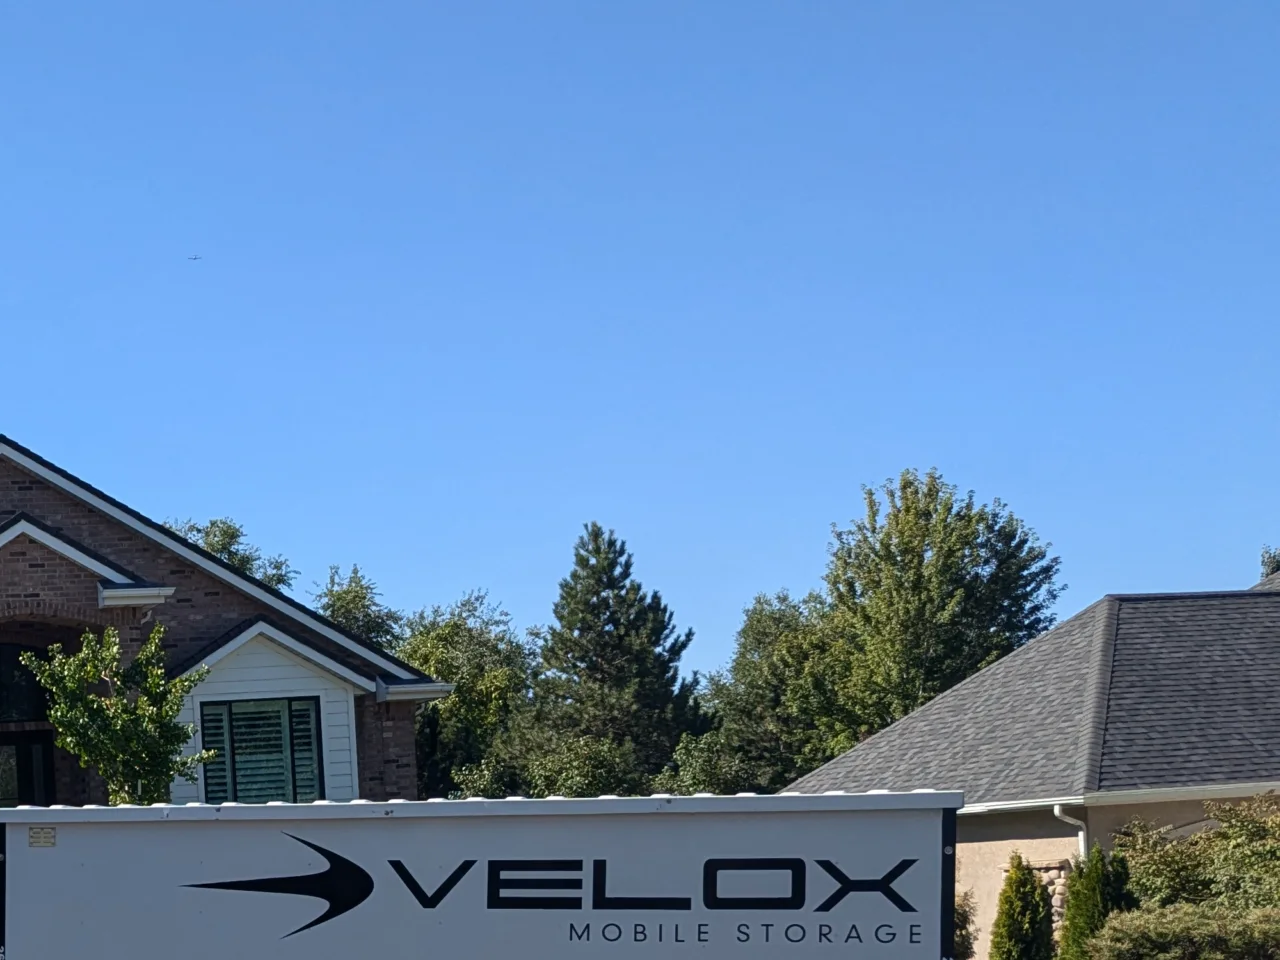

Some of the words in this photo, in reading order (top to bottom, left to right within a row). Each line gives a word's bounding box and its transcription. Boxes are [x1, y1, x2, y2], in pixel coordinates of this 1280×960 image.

[386, 857, 920, 913] VELOX
[569, 922, 709, 943] MOBILE
[736, 923, 922, 944] STORAGE
